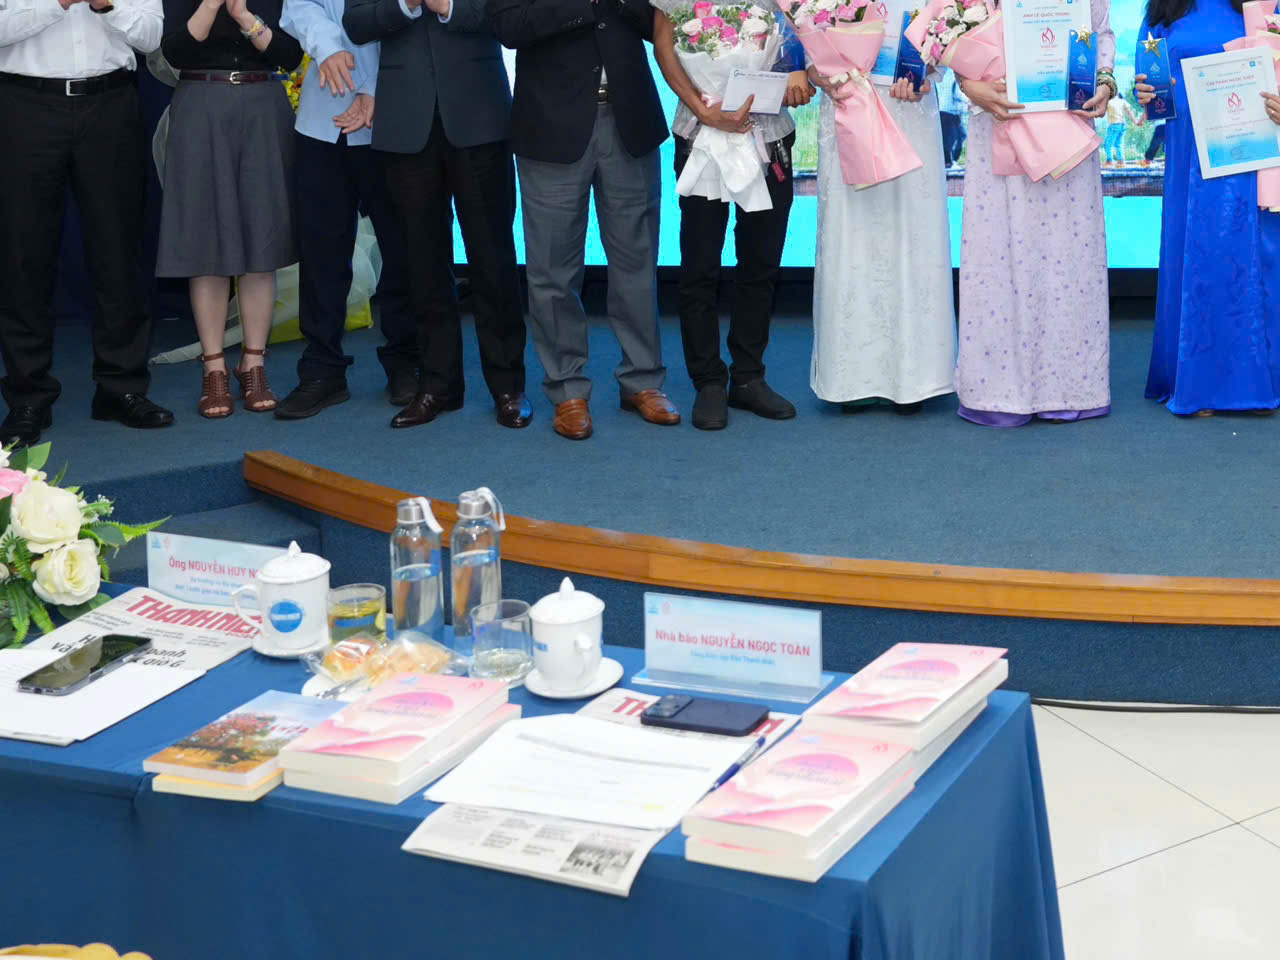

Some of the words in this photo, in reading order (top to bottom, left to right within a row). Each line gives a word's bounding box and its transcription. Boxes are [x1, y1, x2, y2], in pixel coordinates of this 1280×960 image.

[169, 555, 186, 571] Ông
[227, 566, 246, 576] HUY
[747, 639, 777, 655] NGỌC
